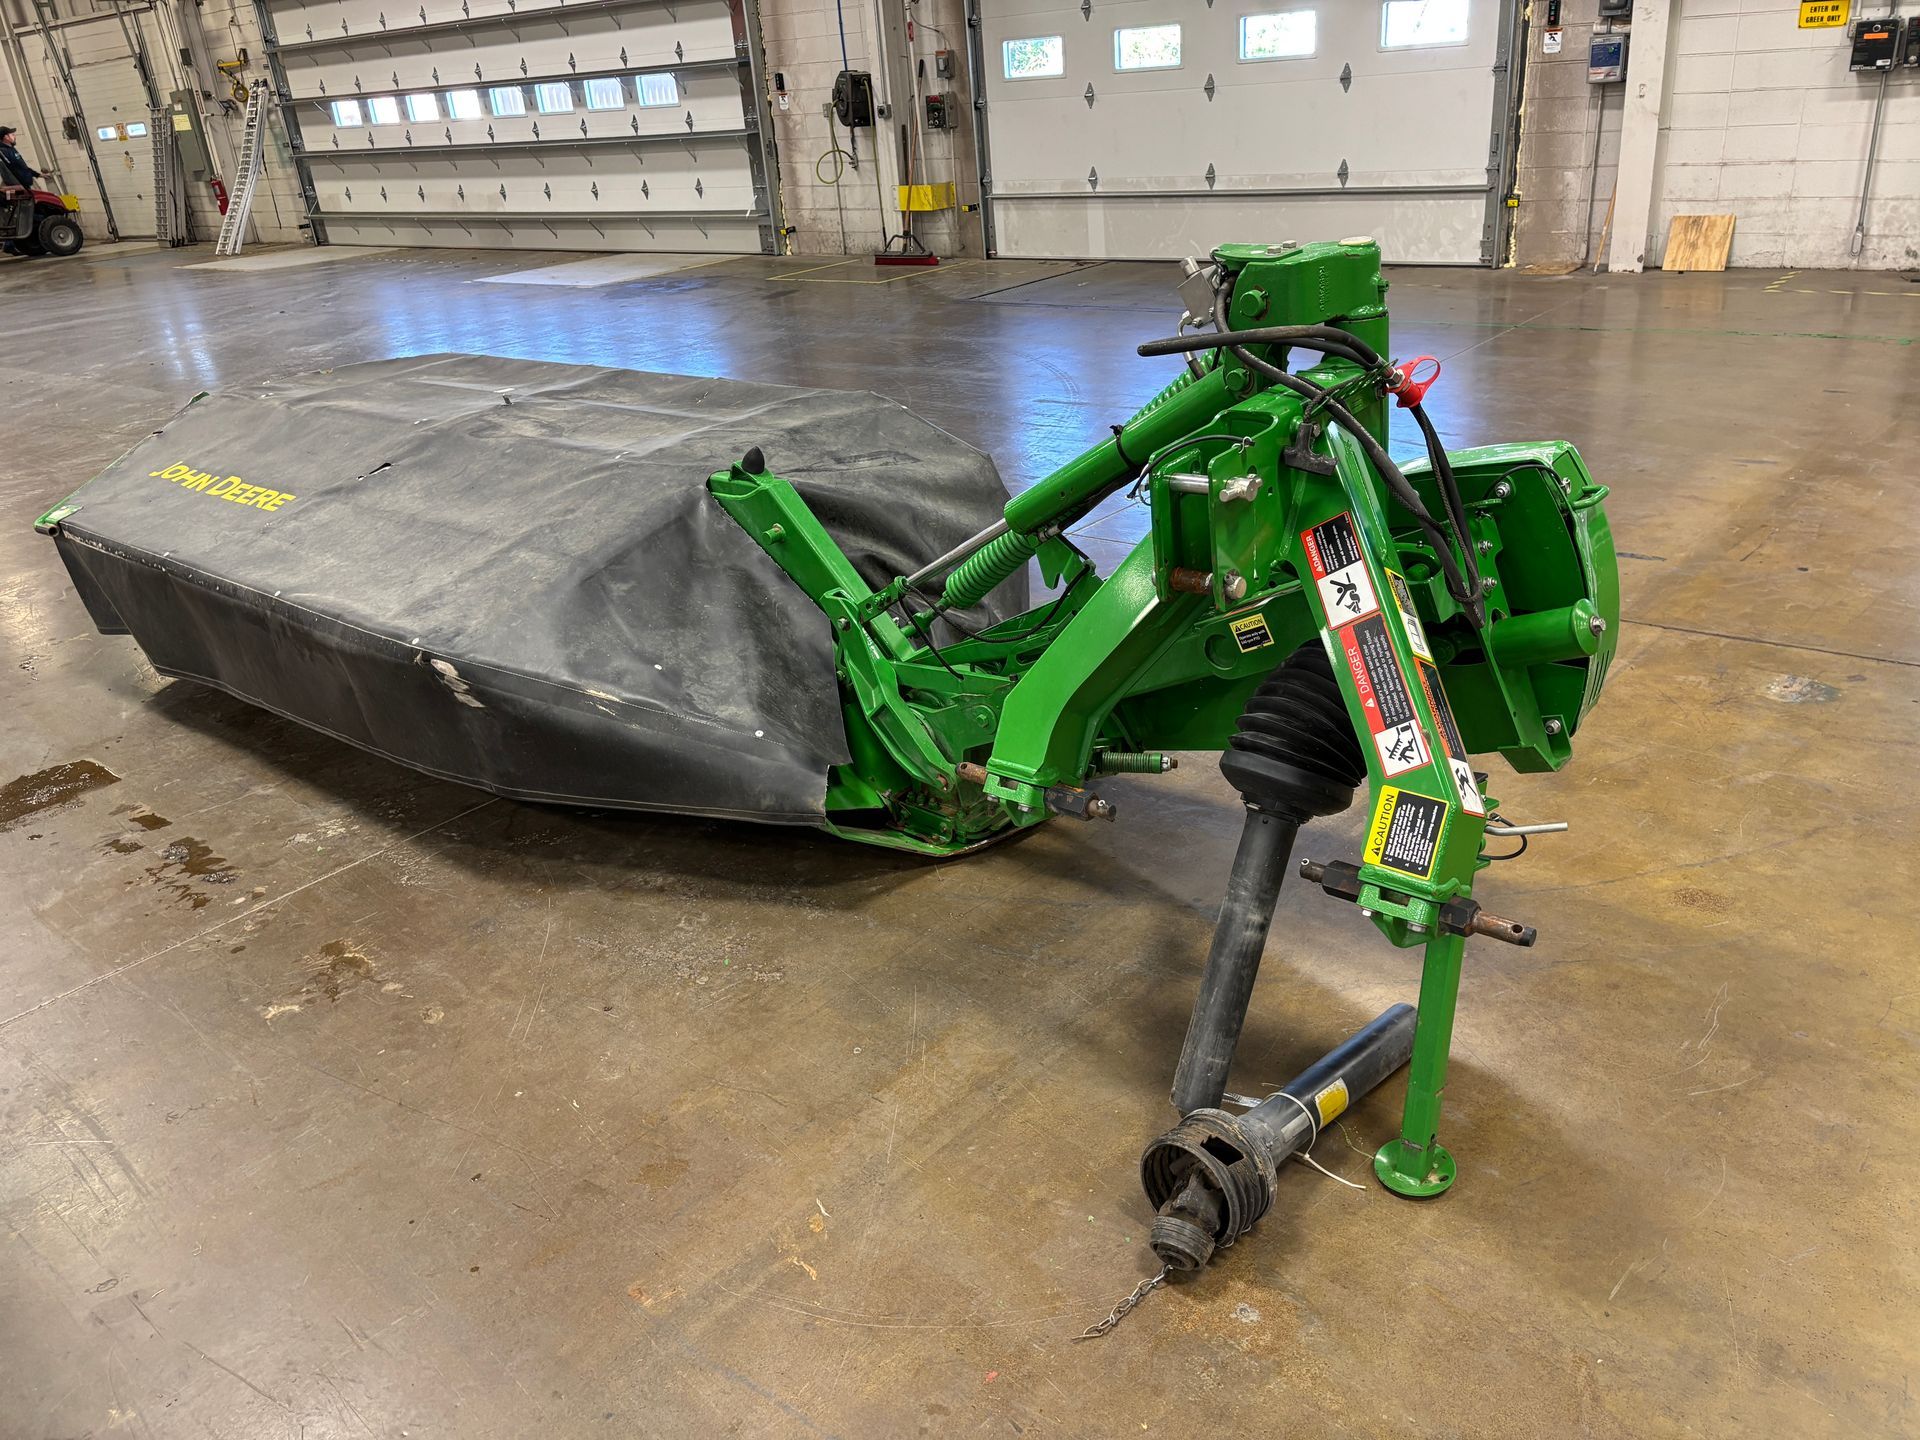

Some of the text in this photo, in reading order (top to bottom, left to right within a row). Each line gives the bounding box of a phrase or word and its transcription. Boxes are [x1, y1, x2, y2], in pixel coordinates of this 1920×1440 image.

[1810, 5, 1829, 13] ENTER
[1805, 14, 1841, 23] GREEN ONLY
[149, 460, 297, 512] JOHN DEERE
[1306, 535, 1320, 566] DANGER
[1240, 618, 1263, 629] CAUTION
[1364, 629, 1373, 645] folded
[1369, 644, 1378, 659] being
[1373, 635, 1384, 658] hydraulic
[1348, 646, 1370, 694] DANGER
[1370, 670, 1378, 684] death
[1376, 666, 1386, 681] wings
[1382, 663, 1395, 691] Mechanical
[1390, 663, 1399, 679] wings
[1394, 678, 1402, 692] allow
[1377, 689, 1386, 704] injury
[1381, 703, 1389, 717] avoid
[1385, 695, 1396, 716] machine
[1402, 701, 1410, 717] failure
[1374, 794, 1395, 845] CAUTION
